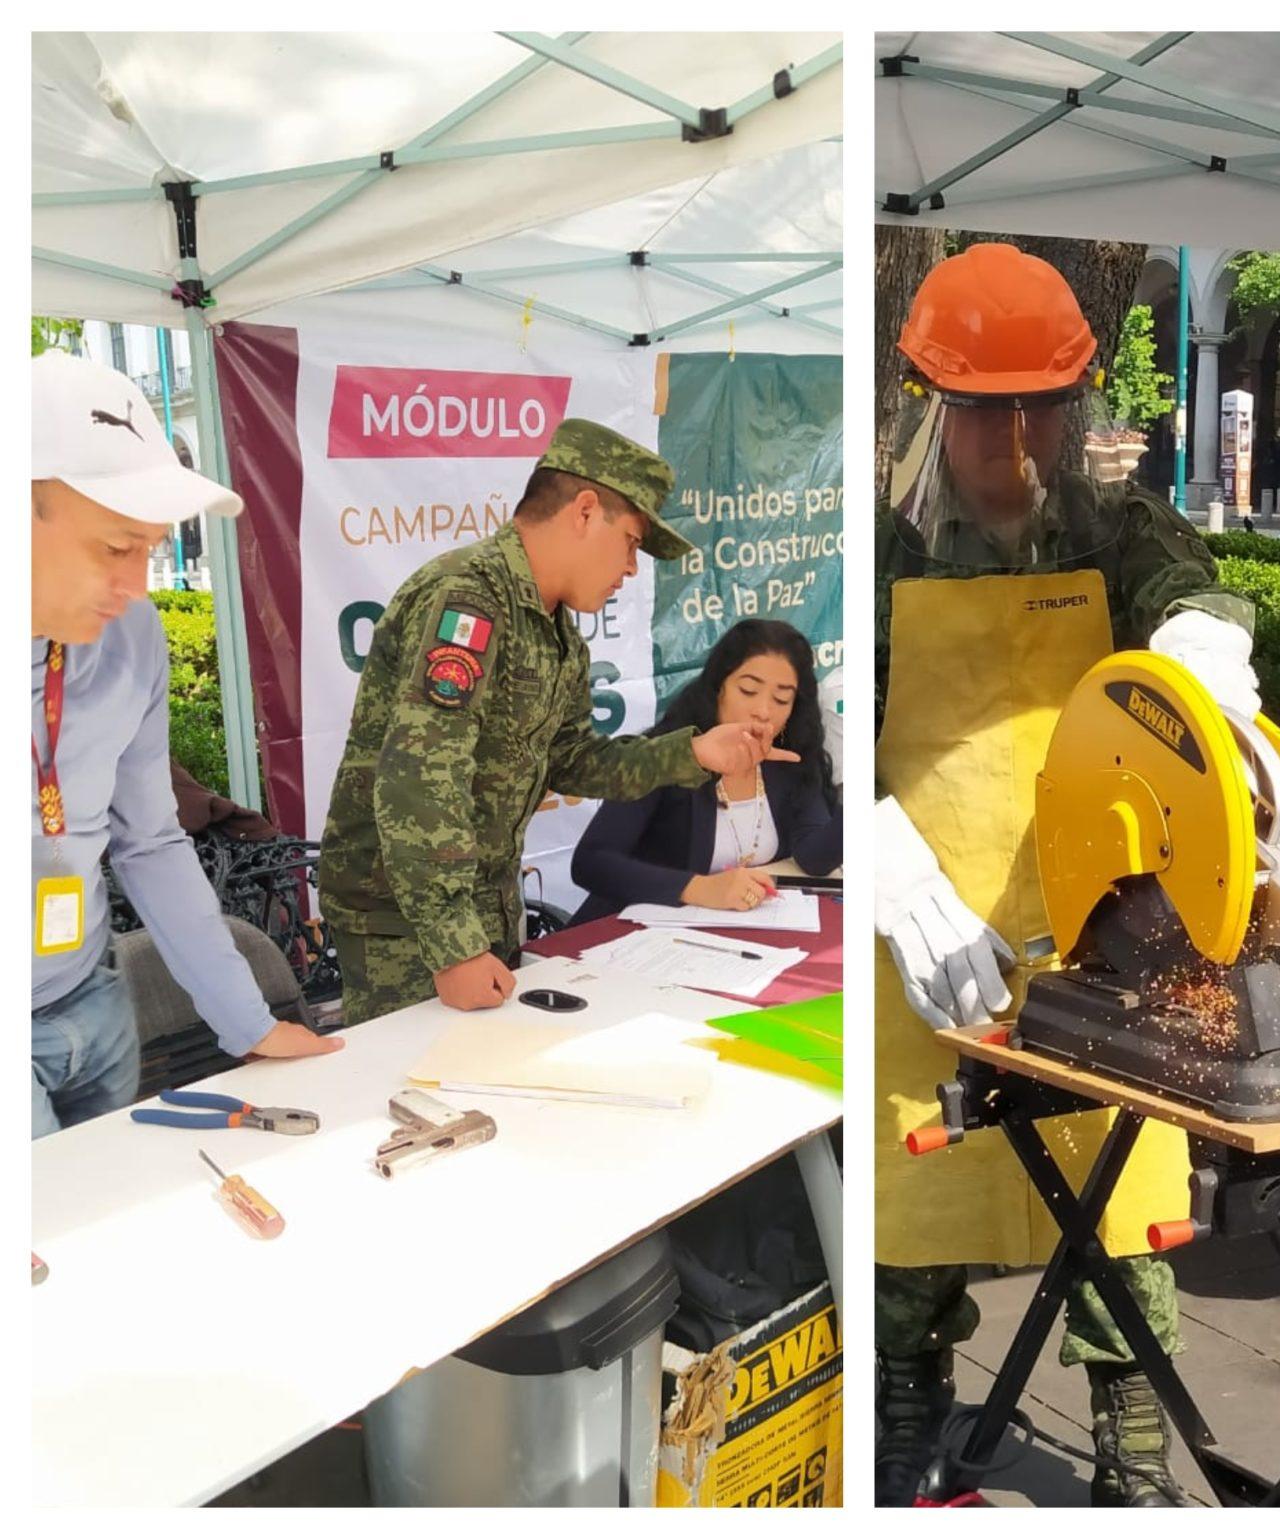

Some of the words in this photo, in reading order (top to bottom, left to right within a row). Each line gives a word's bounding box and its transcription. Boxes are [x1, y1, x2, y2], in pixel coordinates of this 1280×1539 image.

[362, 383, 546, 438] MÓDULO
[681, 547, 704, 575] la
[682, 588, 724, 623] de
[732, 583, 759, 616] la
[1039, 594, 1089, 611] TRUPER
